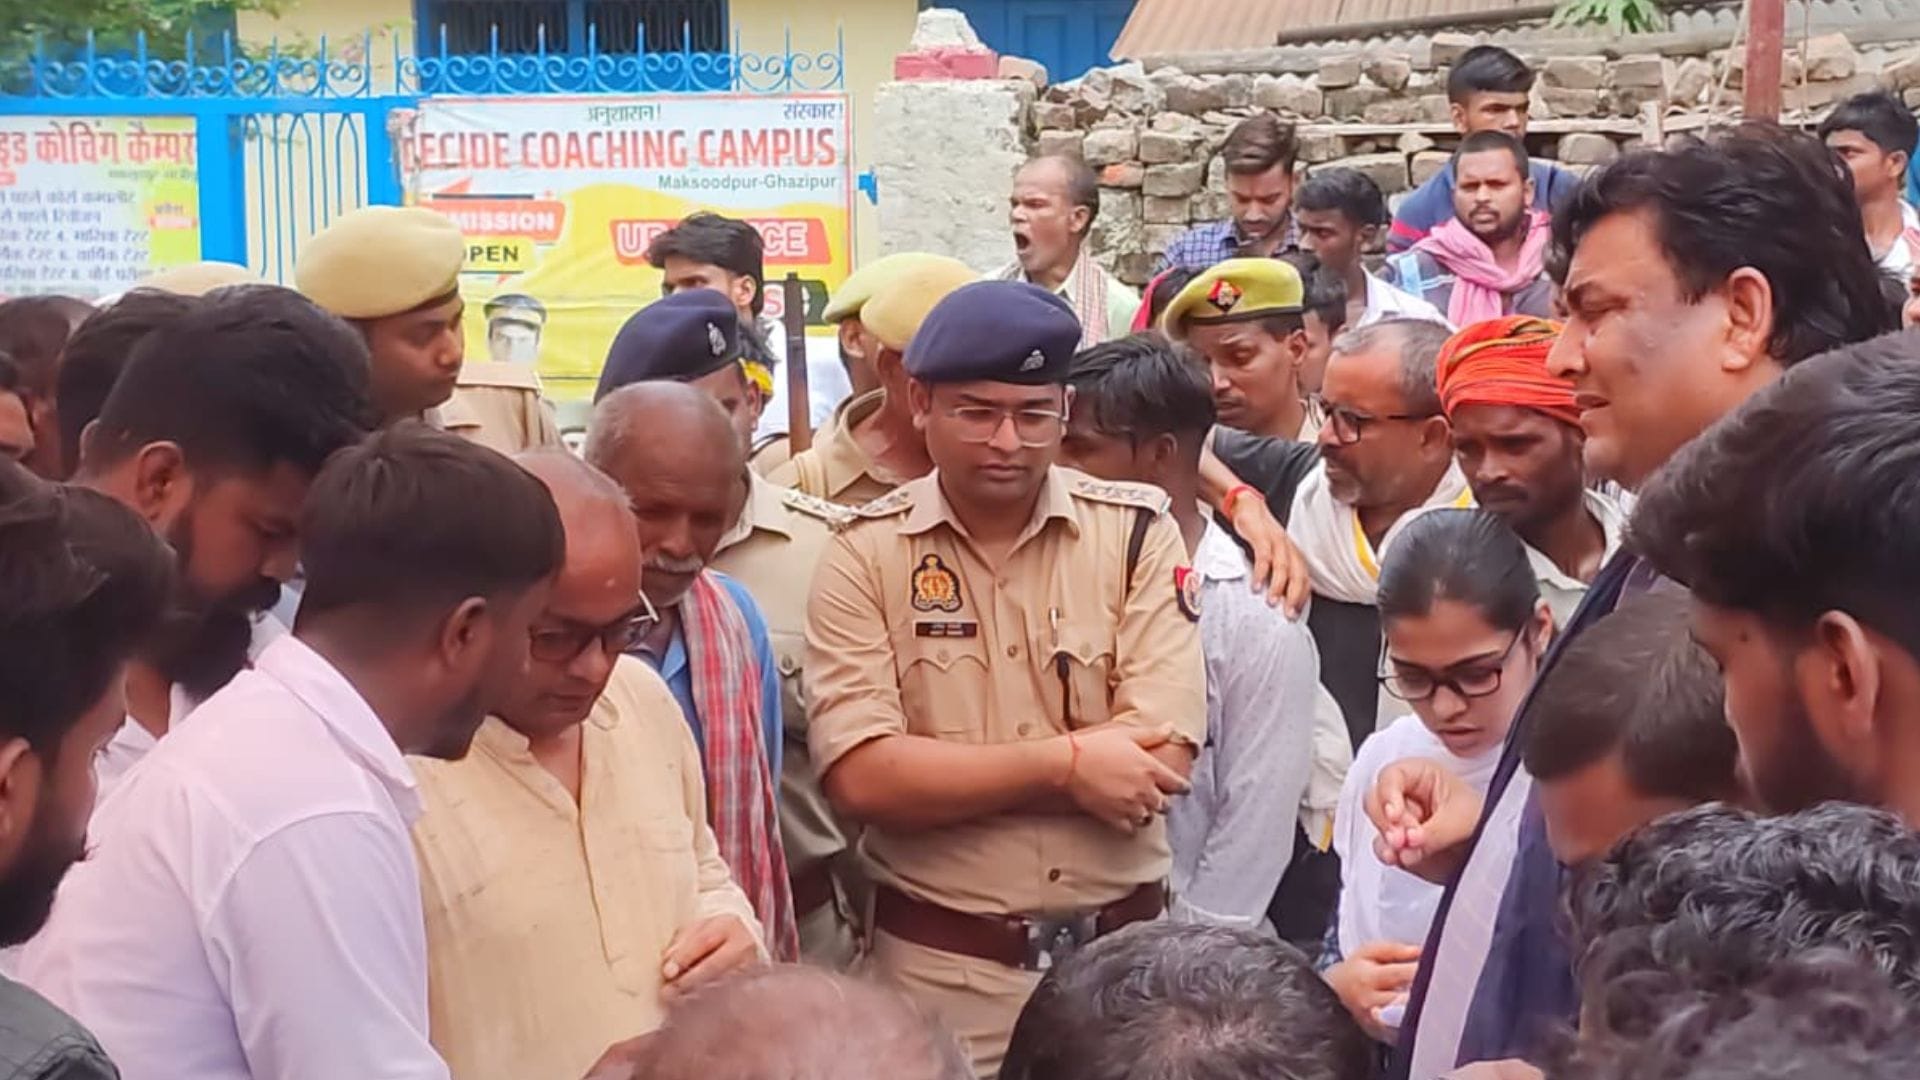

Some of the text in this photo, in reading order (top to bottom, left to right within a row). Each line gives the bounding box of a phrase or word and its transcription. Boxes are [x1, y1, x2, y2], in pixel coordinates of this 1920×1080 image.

[587, 103, 662, 126] अनुशासन!
[783, 101, 843, 120] संस्कार!
[34, 120, 121, 165] कोचिंग
[521, 130, 688, 168] COACHING
[698, 127, 837, 168] CAMPUS
[658, 174, 837, 191] Maksoodpur-Ghazipur
[446, 210, 556, 232] MISSION
[462, 245, 519, 262] PEN
